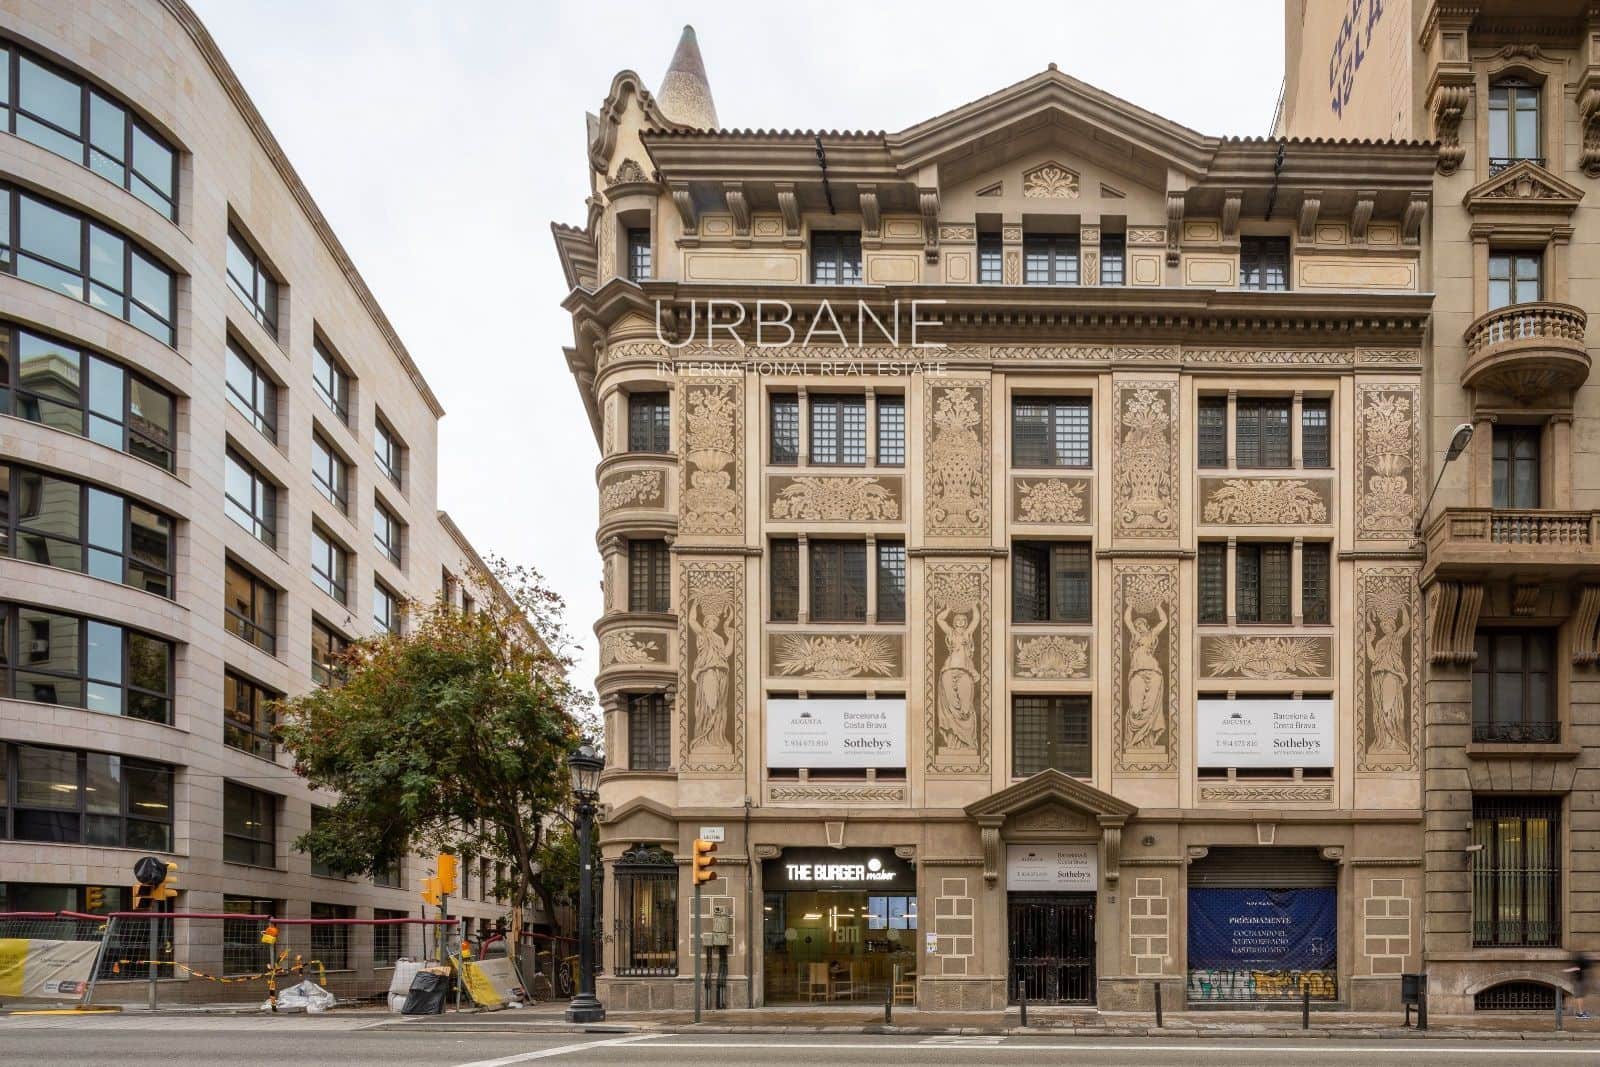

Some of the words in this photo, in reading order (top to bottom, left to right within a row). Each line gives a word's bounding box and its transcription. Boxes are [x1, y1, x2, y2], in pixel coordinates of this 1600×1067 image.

[843, 711, 880, 720] Barcelona
[843, 721, 865, 729] Costa
[866, 721, 888, 729] Brava
[843, 737, 893, 750] Sotheby's
[1273, 737, 1321, 750] Sotheby's
[786, 864, 812, 881] THE
[814, 864, 865, 881] BURGER
[866, 868, 897, 881] maker
[1057, 870, 1091, 880] Sotheby's
